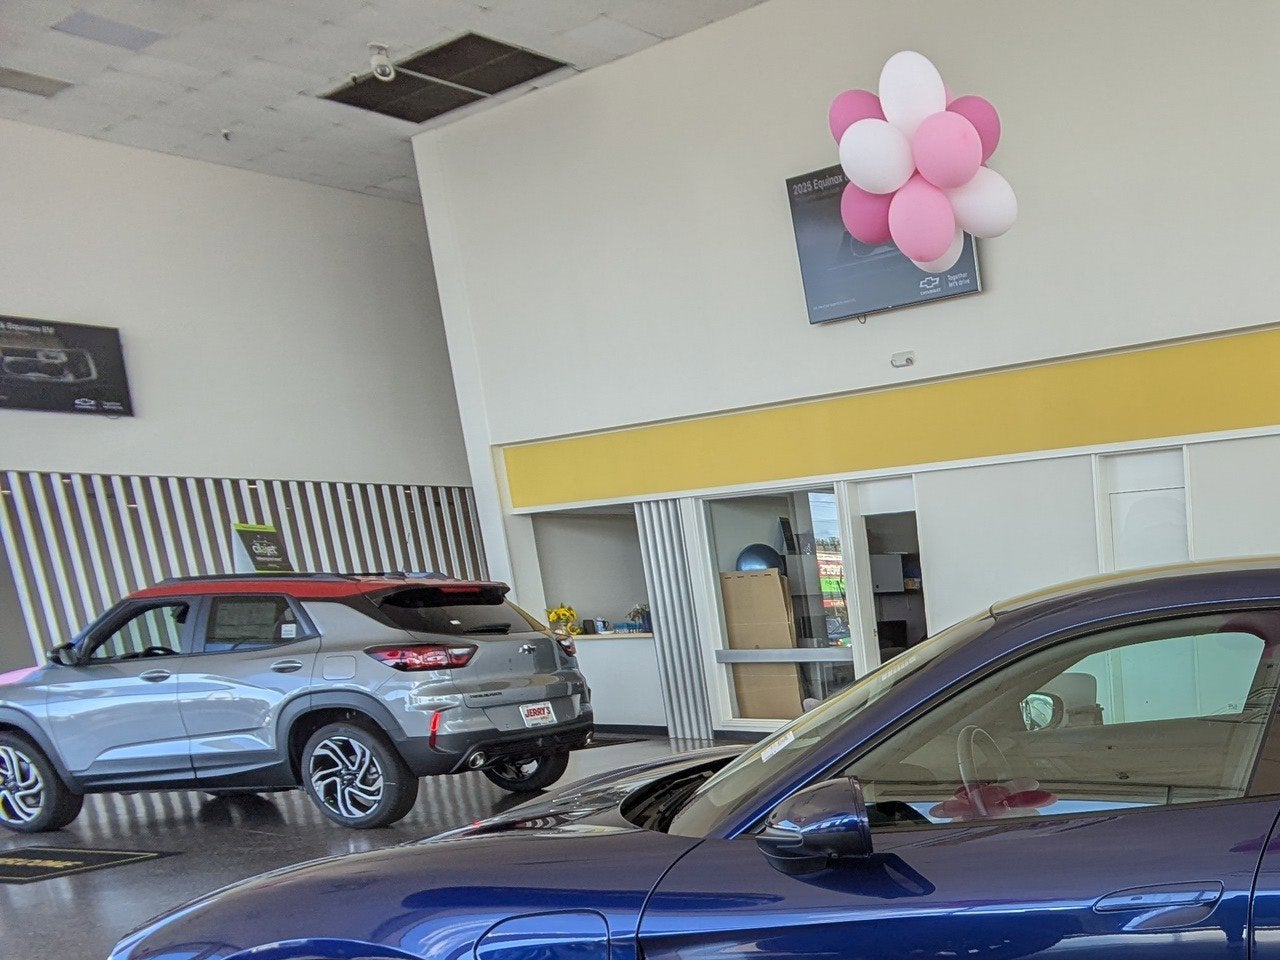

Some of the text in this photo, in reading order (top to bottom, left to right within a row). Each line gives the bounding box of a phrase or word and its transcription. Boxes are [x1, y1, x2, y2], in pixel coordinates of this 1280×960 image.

[793, 180, 812, 195] 2025
[813, 174, 843, 190] Equinox
[525, 706, 551, 718] JERRY'S
